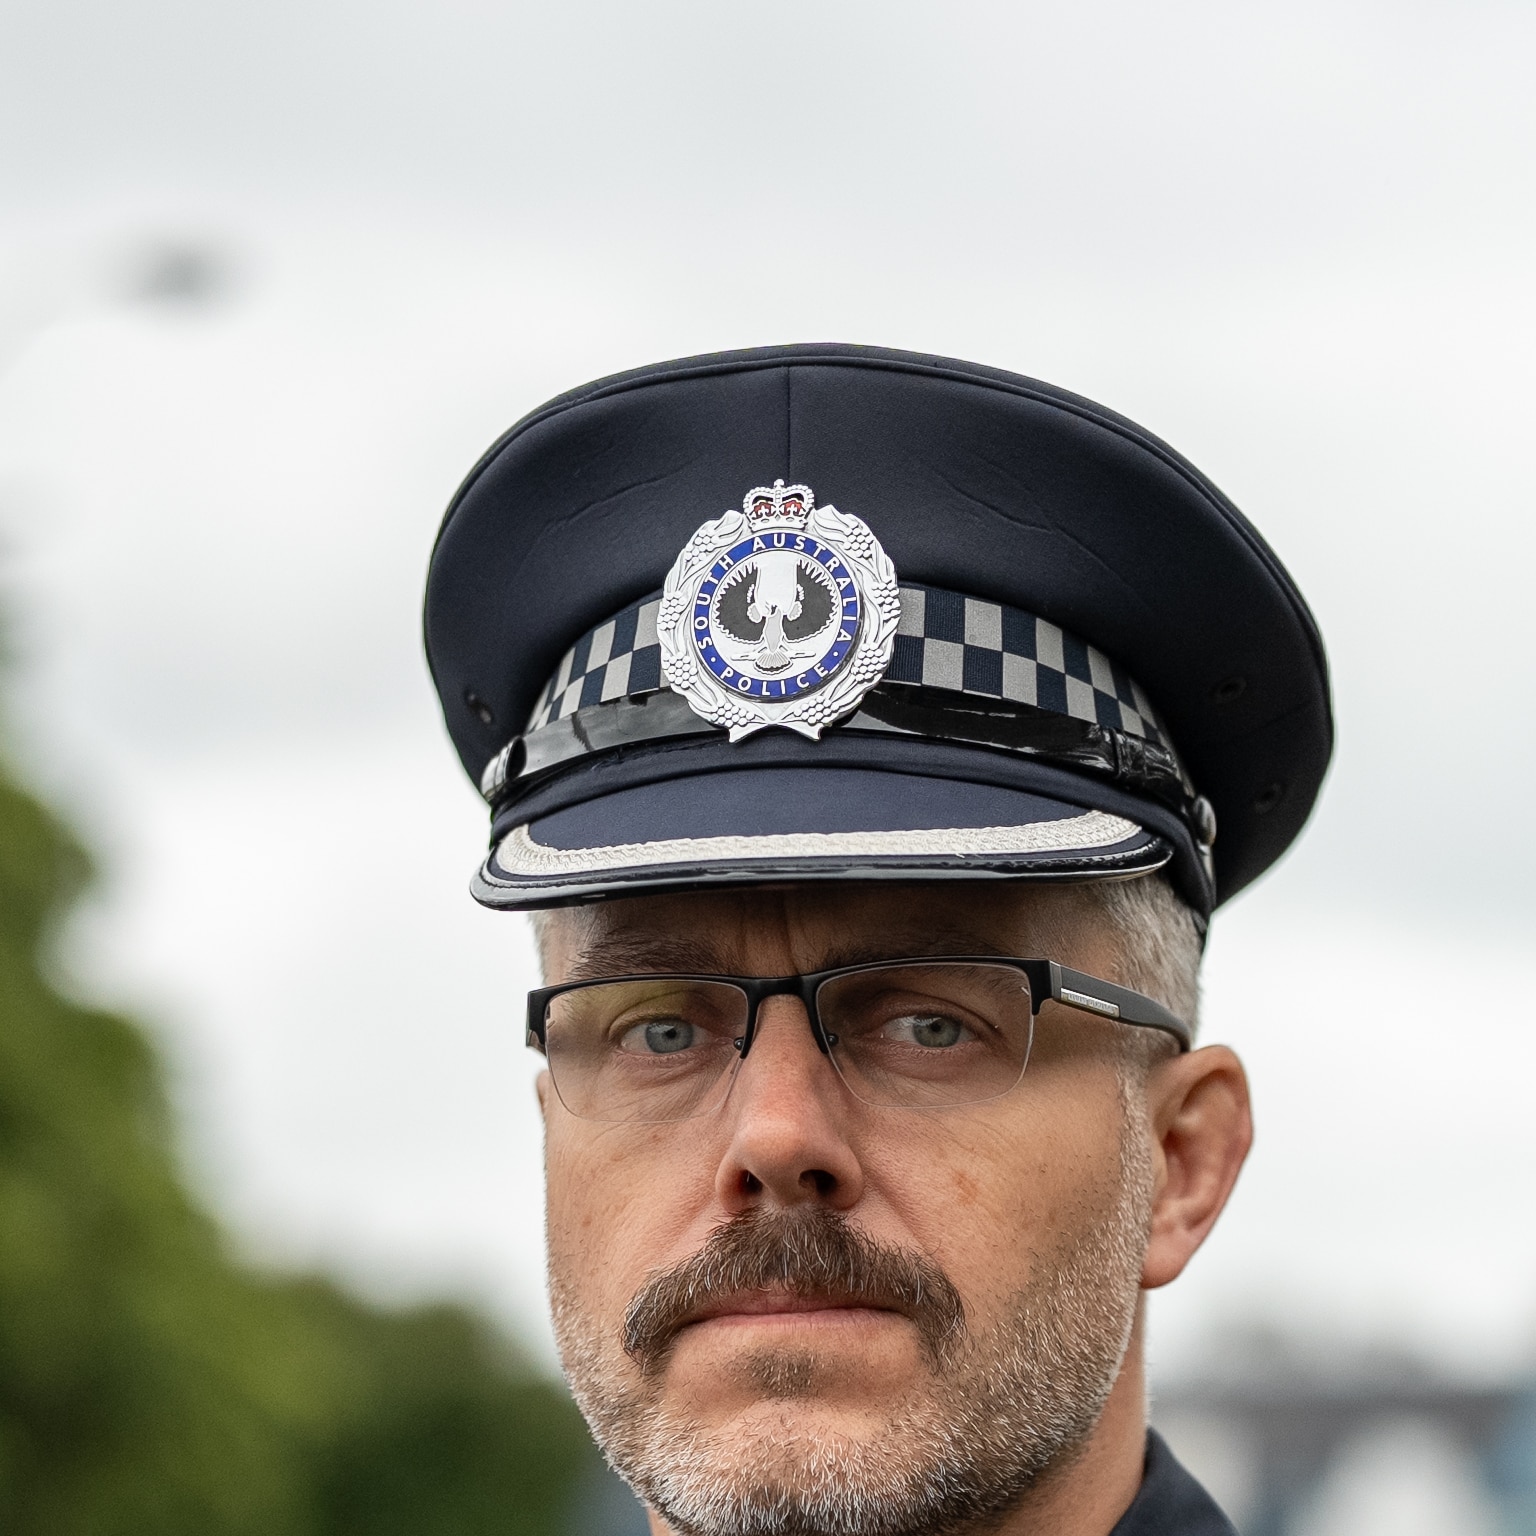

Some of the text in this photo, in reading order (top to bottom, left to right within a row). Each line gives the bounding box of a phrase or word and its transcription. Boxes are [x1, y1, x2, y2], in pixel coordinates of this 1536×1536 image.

[695, 532, 857, 649] SOUTH AUSTRALIA
[721, 663, 829, 695] POLICE
